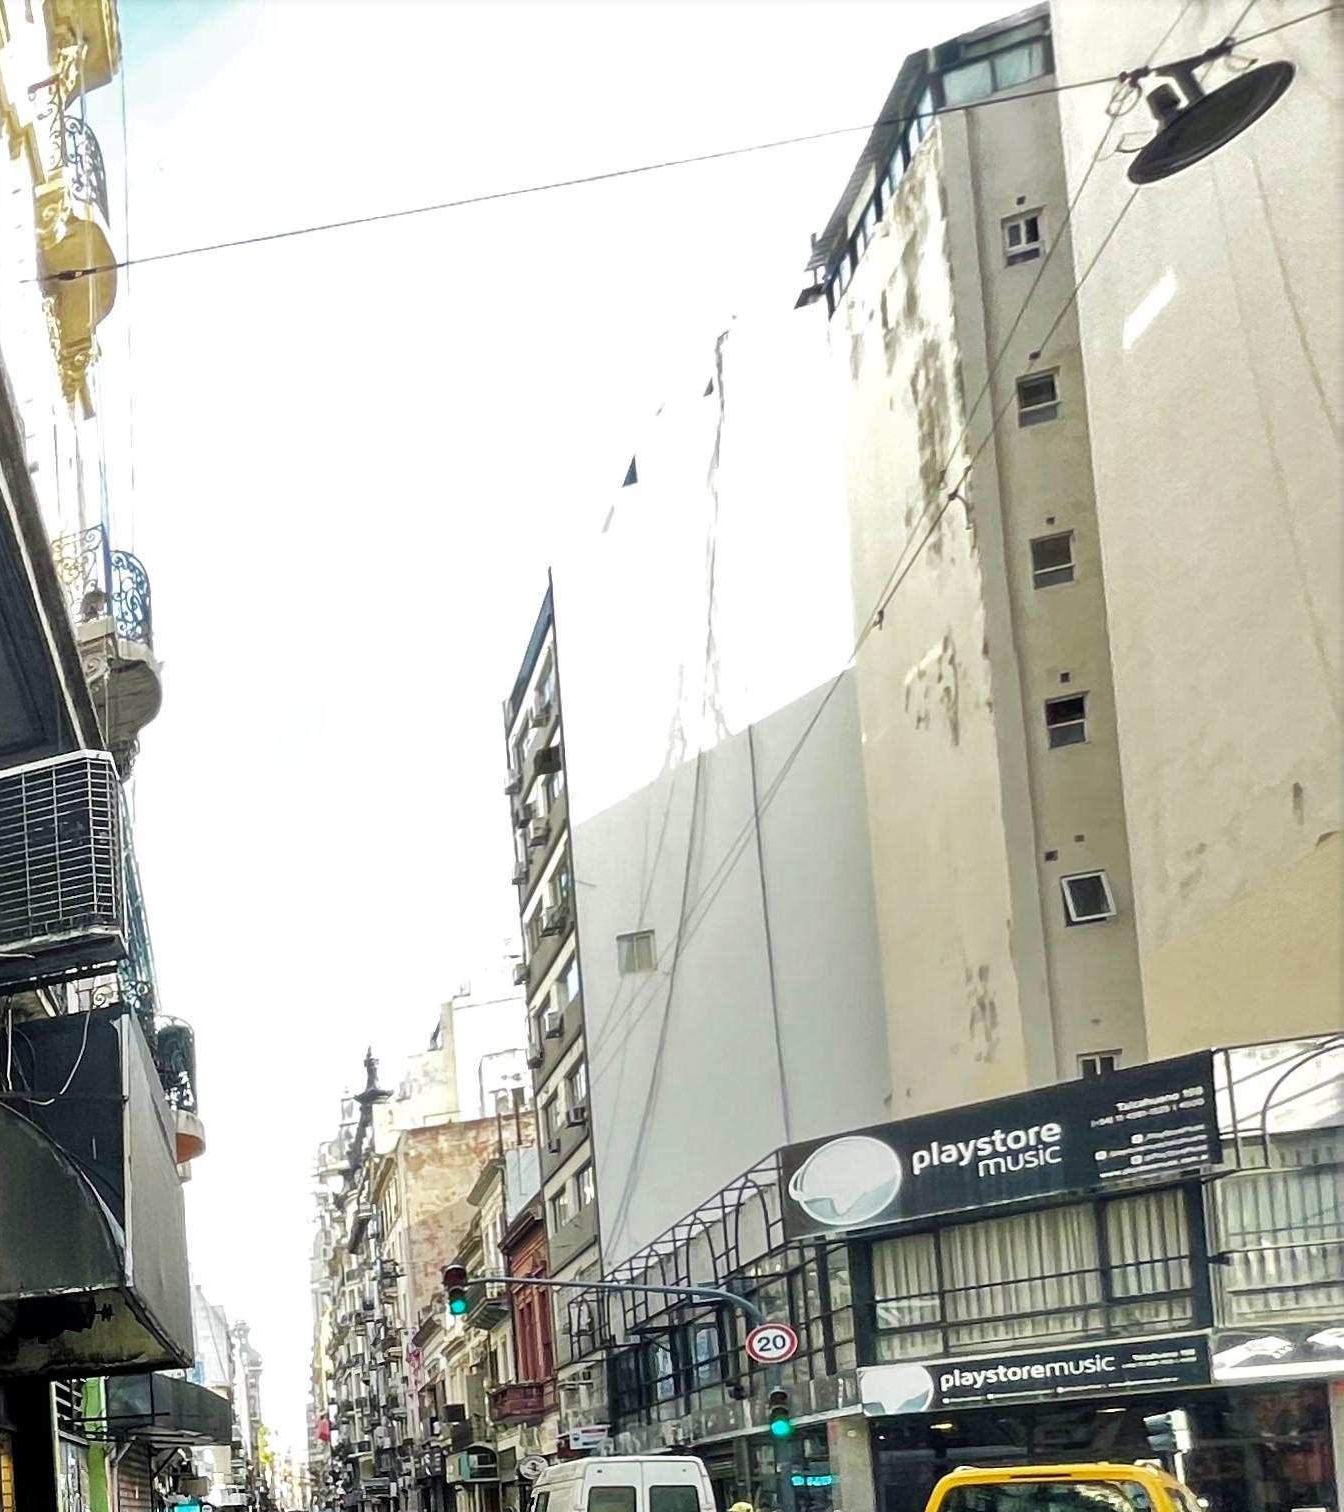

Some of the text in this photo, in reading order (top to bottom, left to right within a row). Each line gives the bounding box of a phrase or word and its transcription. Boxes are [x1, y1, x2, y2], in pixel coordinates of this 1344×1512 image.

[912, 1122, 1062, 1176] playstore
[977, 1144, 1063, 1177] music
[757, 1334, 787, 1352] 20
[940, 1354, 1116, 1392] playstoremusic
